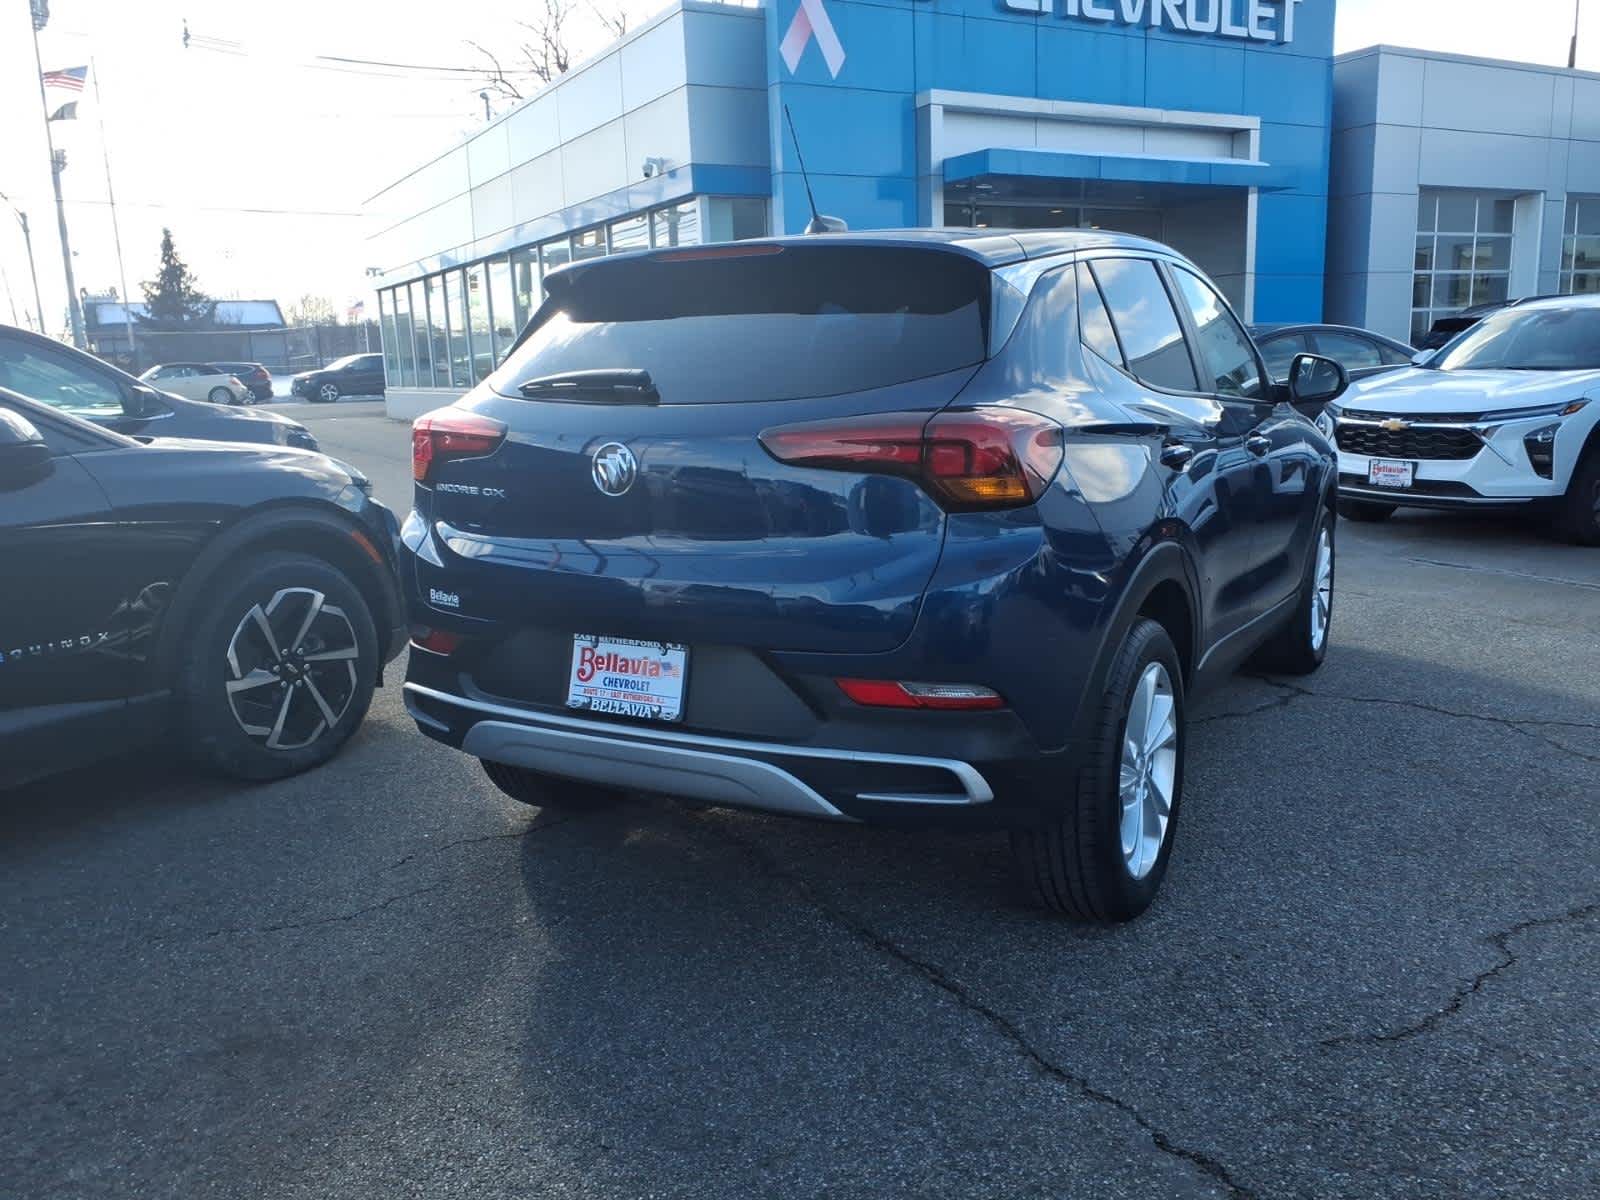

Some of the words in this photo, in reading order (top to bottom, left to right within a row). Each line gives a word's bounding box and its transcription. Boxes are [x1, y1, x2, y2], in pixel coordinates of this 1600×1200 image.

[999, 0, 1299, 42] VROLET
[436, 483, 479, 495] ENCORE
[577, 647, 661, 682] Bellavia
[602, 676, 650, 692] CHEVROLET
[590, 699, 652, 719] BELLAVIA
